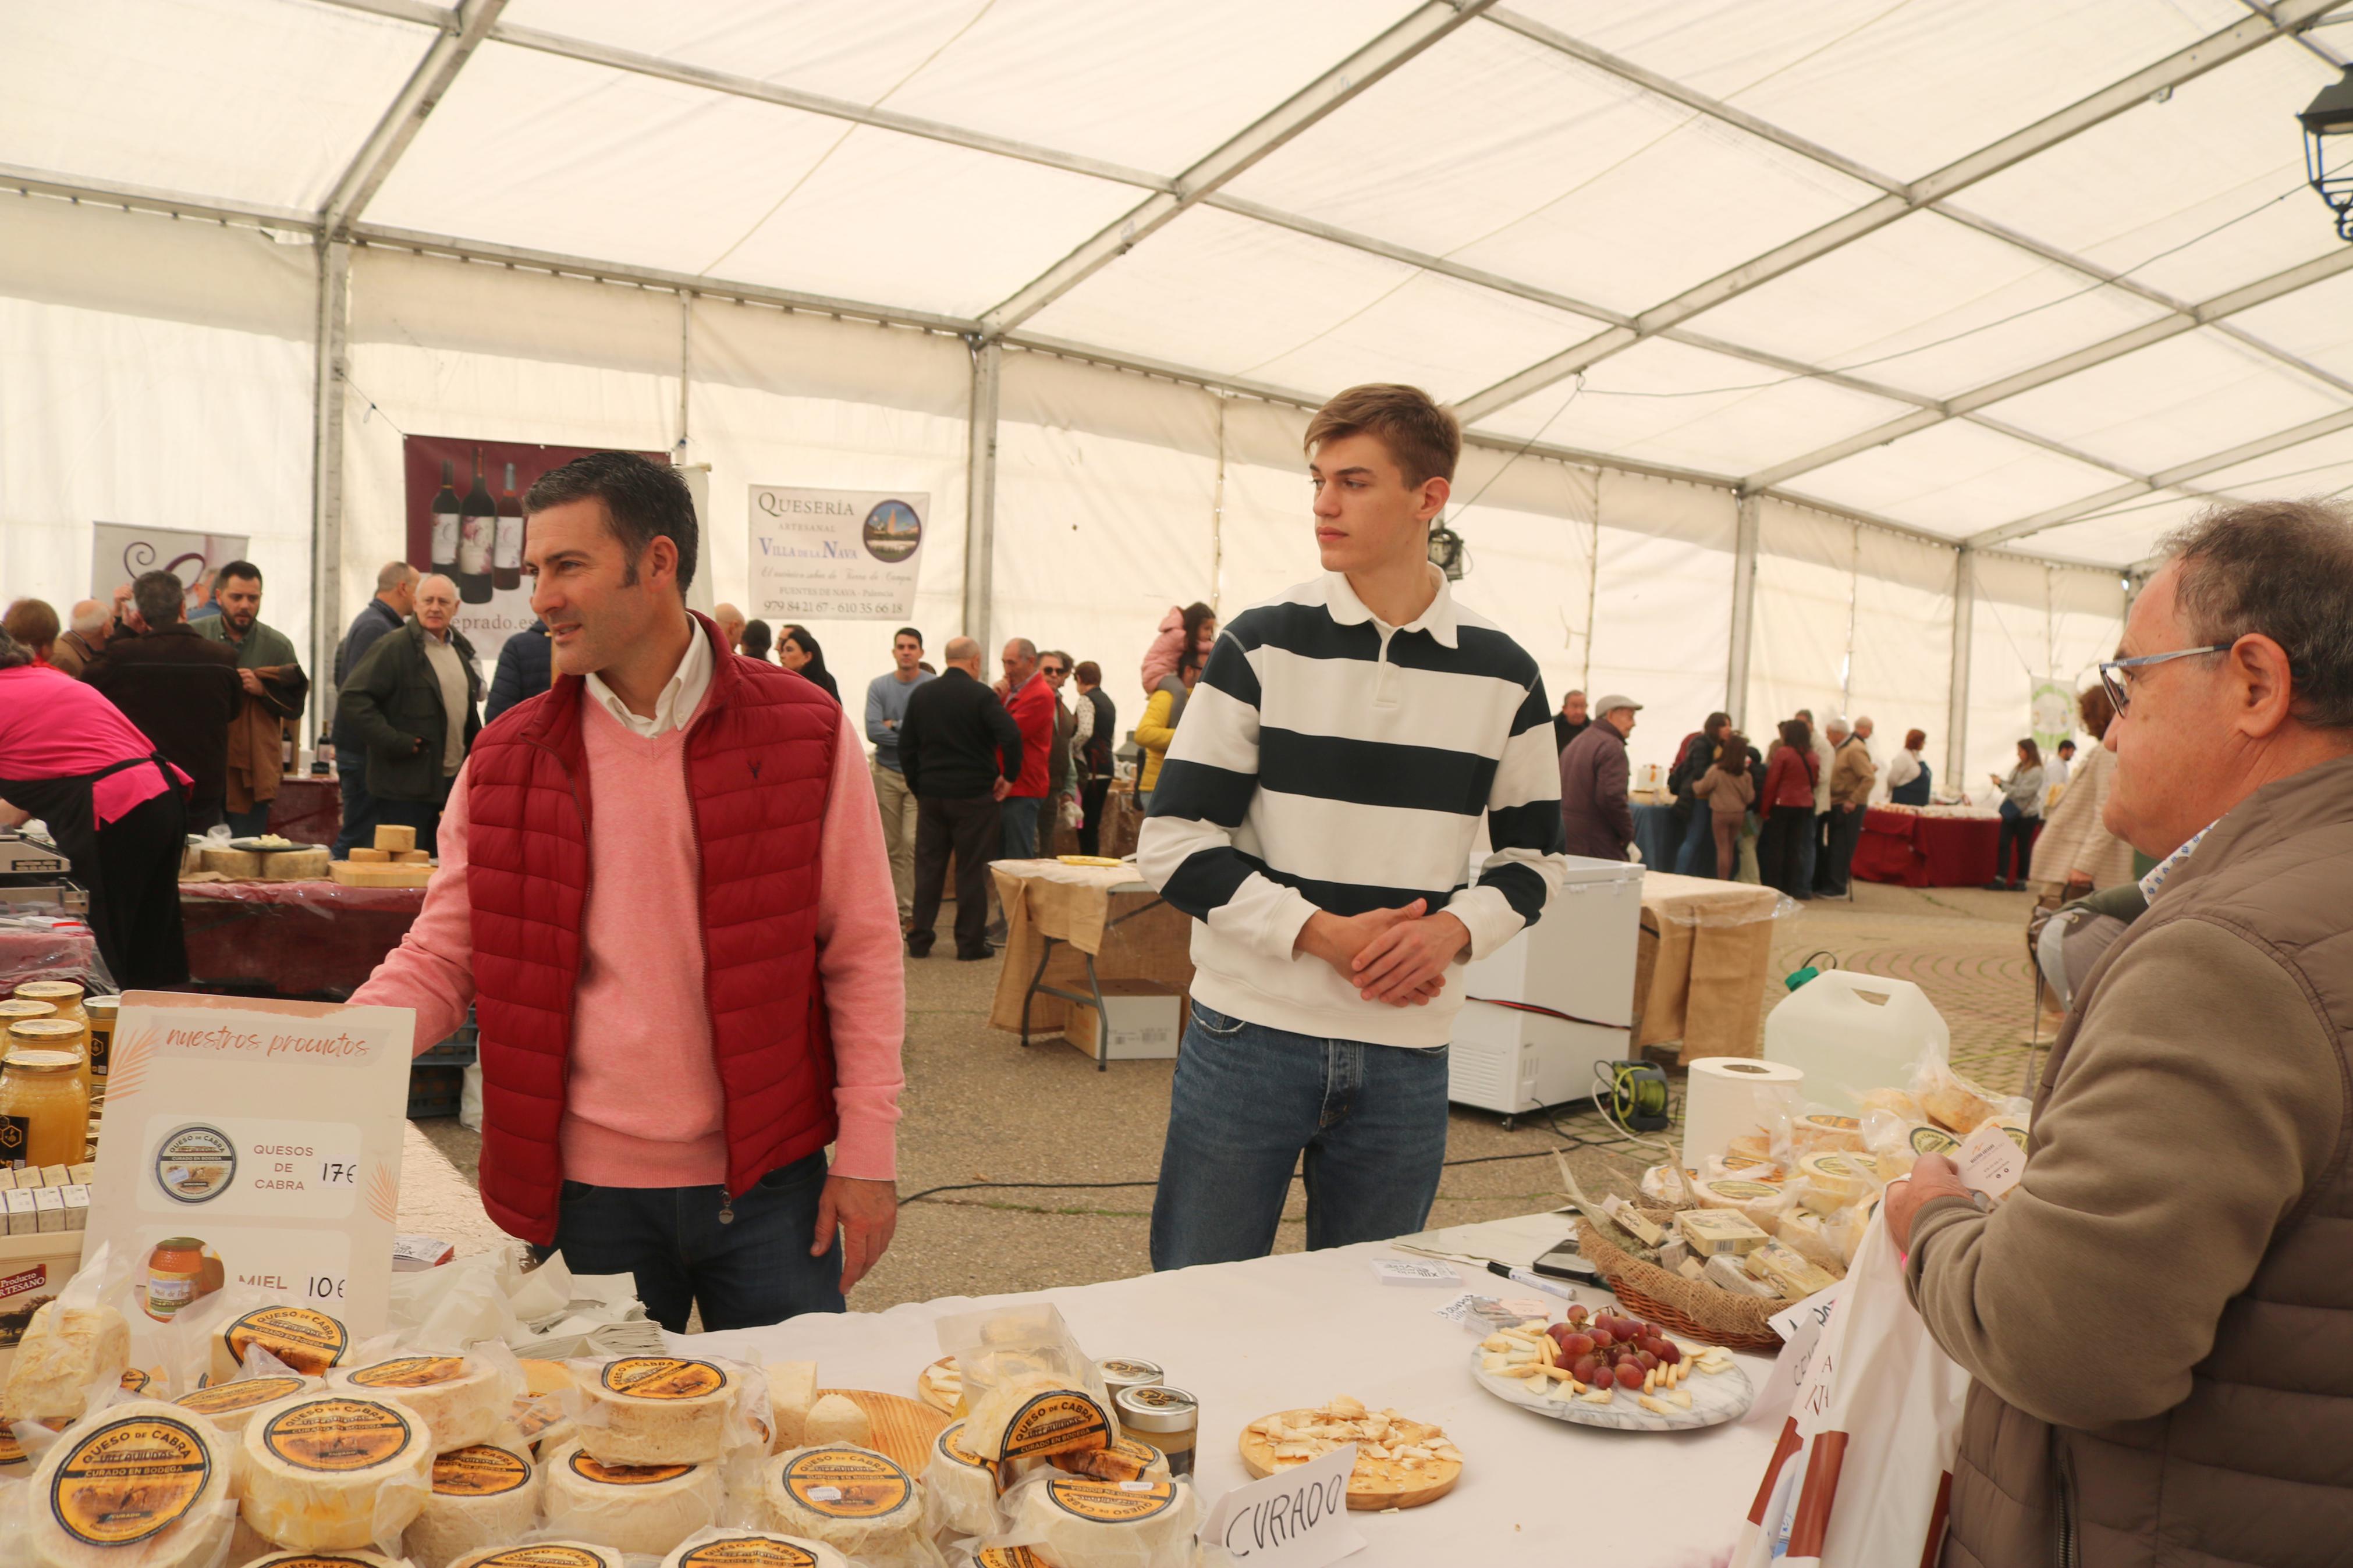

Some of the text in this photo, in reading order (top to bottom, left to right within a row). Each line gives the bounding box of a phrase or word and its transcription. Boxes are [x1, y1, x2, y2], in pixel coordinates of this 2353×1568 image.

[758, 492, 854, 517] QUESERÍA
[823, 540, 858, 559] NAVA
[779, 586, 817, 596] FUENTES
[833, 588, 857, 597] NAVA
[764, 600, 784, 610] 979
[787, 600, 800, 611] 84
[816, 602, 828, 612] 67
[837, 602, 857, 613] 610
[875, 603, 889, 614] 66
[166, 1026, 262, 1051] nuestros
[170, 1136, 193, 1153] QUESO
[204, 1136, 225, 1153] CABRA
[254, 1145, 314, 1156] QUESOS
[275, 1163, 293, 1172] DE
[322, 1163, 357, 1183] 17€
[255, 1179, 304, 1190] CABRA
[1, 1273, 37, 1288] Producto
[309, 1277, 345, 1298] 10€
[257, 1311, 297, 1322] QUESO
[312, 1317, 335, 1340] CABRA
[255, 1326, 284, 1337] CURADO
[295, 1336, 325, 1347] BODEGA
[286, 1407, 324, 1427] QUESO
[345, 1406, 386, 1421] CABRA
[1016, 1408, 1046, 1442] QUESO
[1062, 1402, 1093, 1422] CABRA
[292, 1425, 329, 1434] CURADO
[83, 1432, 130, 1464] QUESO
[152, 1430, 191, 1459] CABRA
[1021, 1439, 1050, 1453] CURADO
[1062, 1428, 1090, 1441] BODEGA
[481, 1450, 514, 1466] CABRA
[800, 1456, 832, 1472] QUESO
[850, 1456, 886, 1472] CABRA
[86, 1467, 126, 1477] CURADO
[144, 1465, 183, 1474] BODEGA
[1071, 1485, 1105, 1494] BODEGA
[1117, 1491, 1150, 1499] CURADO
[1063, 1493, 1095, 1512] CABRA
[1114, 1503, 1153, 1516] QUESO
[1226, 1474, 1342, 1556] CURADO
[505, 1549, 551, 1560] QUESO
[704, 1544, 745, 1556] QUESO
[765, 1543, 800, 1561] CABRA
